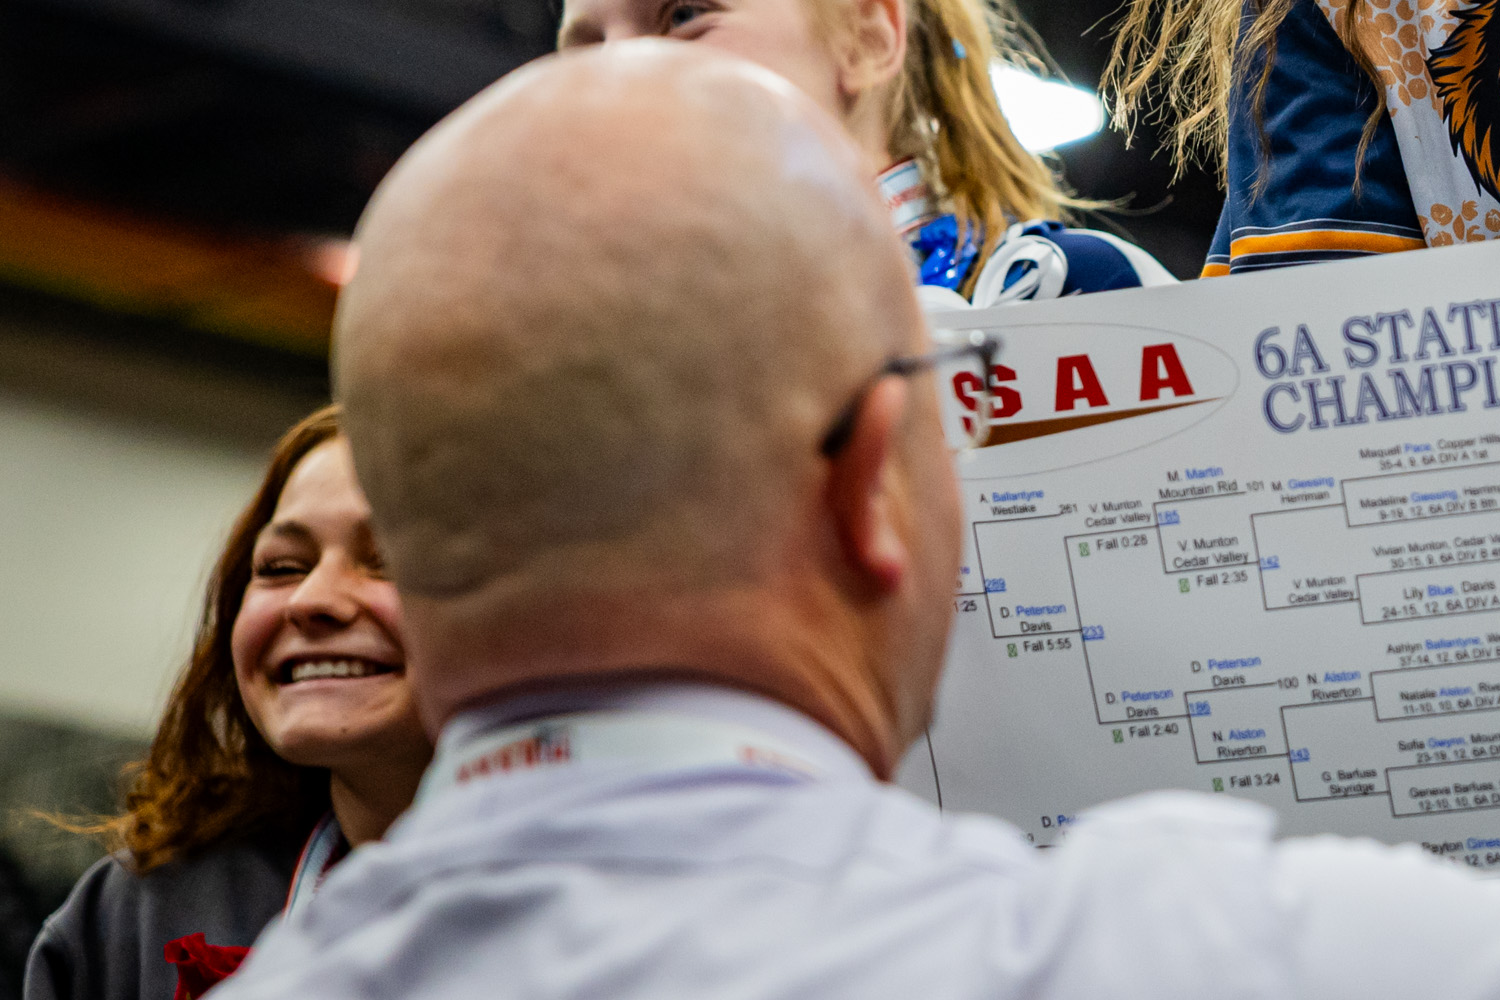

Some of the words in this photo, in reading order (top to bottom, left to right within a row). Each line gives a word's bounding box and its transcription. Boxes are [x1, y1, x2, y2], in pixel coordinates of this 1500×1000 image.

[1254, 323, 1330, 380] 6A
[1167, 471, 1182, 482] M.
[1186, 466, 1223, 480] Martin
[1159, 484, 1214, 499] Mountain
[1218, 480, 1237, 491] Rid
[1103, 500, 1142, 513] Munton
[1085, 516, 1116, 528] Cedar
[1119, 512, 1152, 525] Valley
[1096, 538, 1119, 550] Fall
[1122, 535, 1148, 548] 0:28
[1194, 536, 1238, 549] Munton
[1173, 556, 1209, 568] Cedar
[1213, 552, 1249, 564] Valley
[1197, 575, 1219, 586] Fall
[1222, 570, 1248, 583] 2:35
[1306, 574, 1346, 588] Munton
[1288, 592, 1320, 604] Cedar
[1325, 588, 1354, 601] Valley
[1403, 587, 1424, 600] Lily
[1462, 580, 1496, 592] Davis
[1000, 608, 1011, 619] D.
[1016, 604, 1066, 617] Peterson
[1020, 621, 1052, 633] Davis
[1023, 640, 1044, 652] Fall
[1191, 661, 1205, 672] D.
[1208, 657, 1261, 670] Peterson
[1212, 675, 1246, 688] Davis
[1105, 692, 1119, 704] D.
[1122, 688, 1174, 702] Peterson
[1311, 686, 1362, 701] Riverton
[1126, 706, 1160, 719] Davis
[1129, 726, 1151, 739] Fall
[1217, 744, 1267, 758] Riverton
[1230, 776, 1252, 788] Fall
